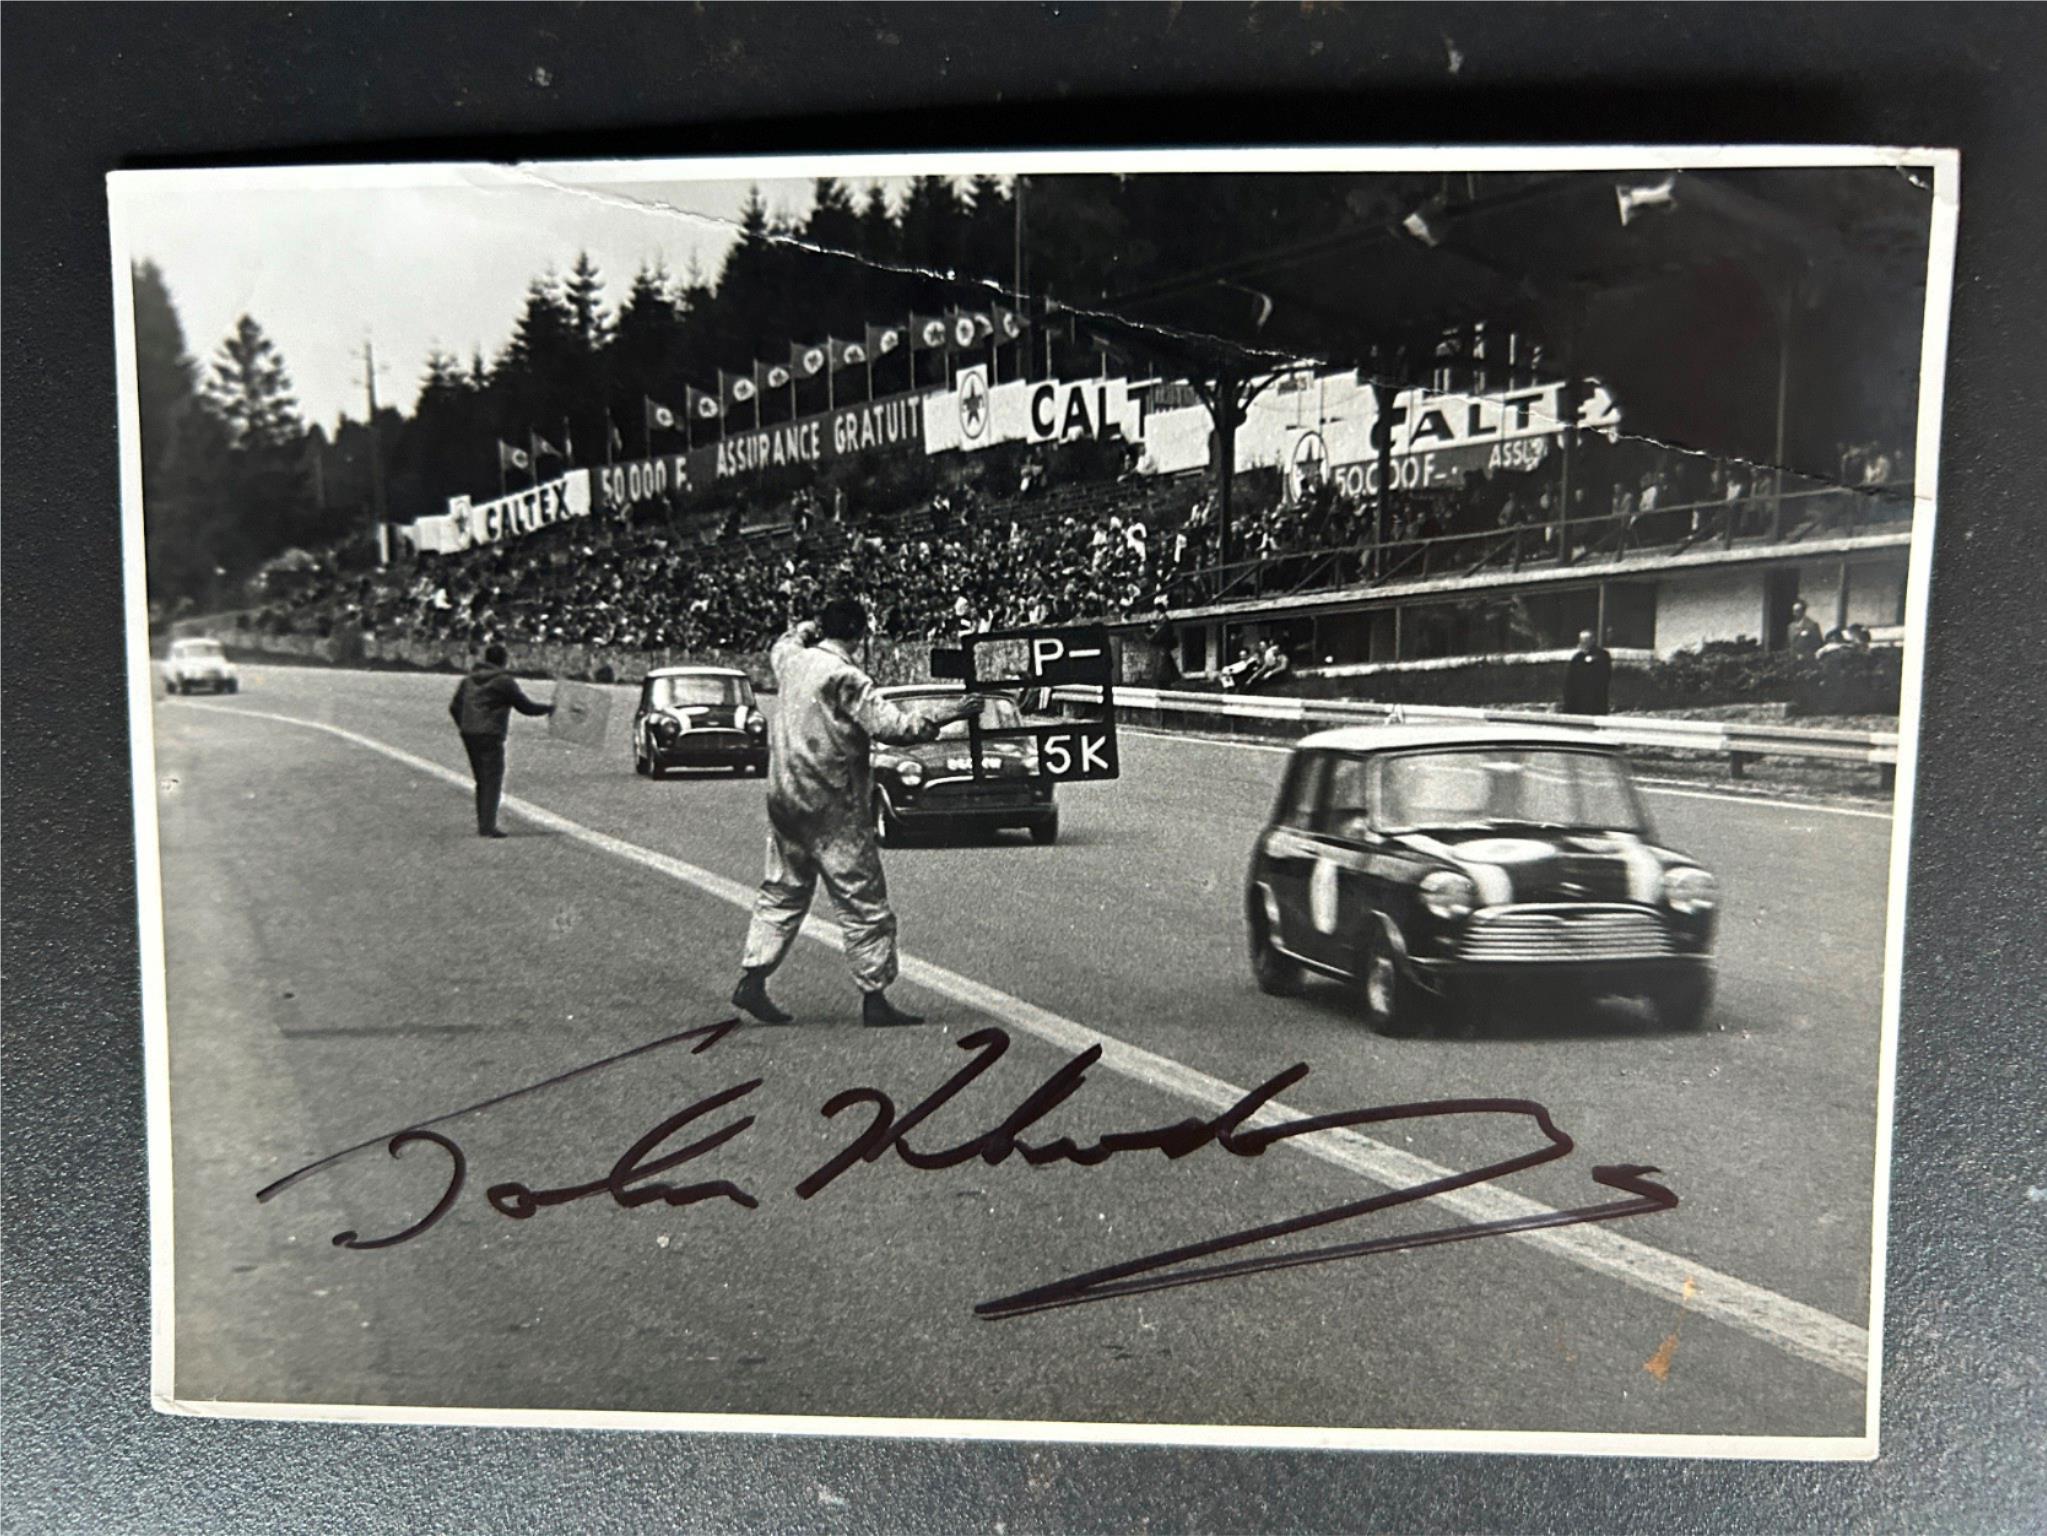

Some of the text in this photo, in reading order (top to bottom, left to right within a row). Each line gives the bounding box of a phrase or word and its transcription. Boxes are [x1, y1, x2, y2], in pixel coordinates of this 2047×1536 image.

[716, 421, 821, 479] ASSURANCE
[834, 396, 919, 455] GRATUIT
[1370, 388, 1613, 451] CALT
